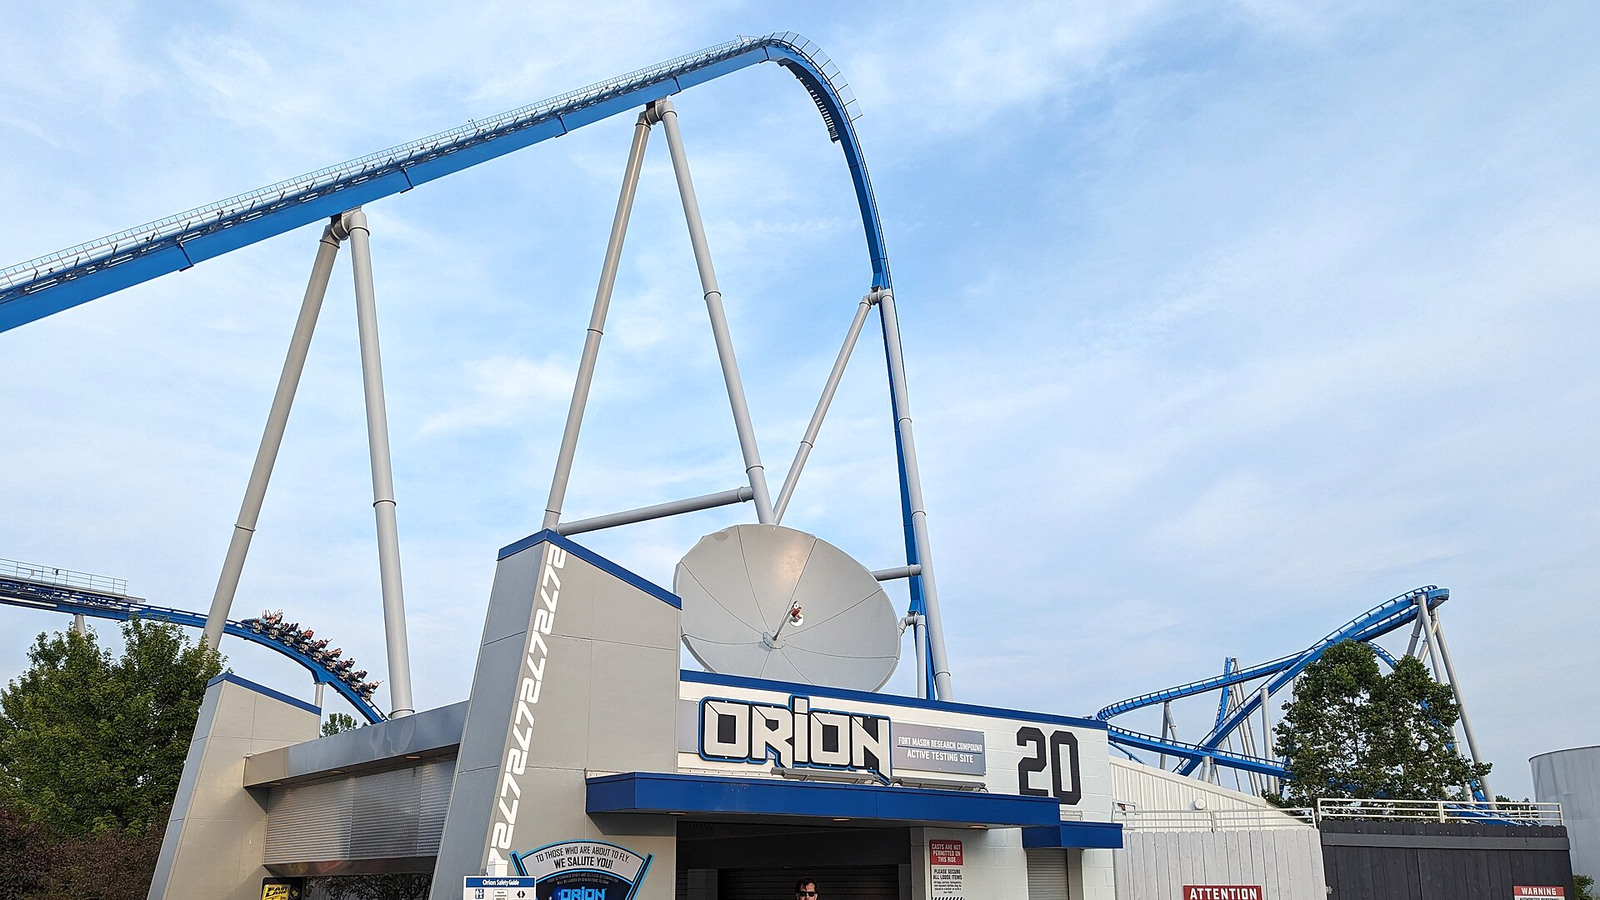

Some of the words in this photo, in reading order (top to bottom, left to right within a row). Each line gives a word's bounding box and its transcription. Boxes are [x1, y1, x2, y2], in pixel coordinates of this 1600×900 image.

[898, 736, 911, 746] FORT
[912, 737, 930, 748] MASON
[931, 739, 956, 750] RESEARCH
[957, 741, 983, 753] COMPOUND
[907, 749, 930, 760] ACTIVE
[931, 751, 958, 762] TESTING
[959, 753, 974, 764] SITE
[1016, 726, 1083, 806] 20
[535, 854, 544, 864] TO
[545, 848, 564, 861] THOSE
[565, 846, 579, 855] WHO
[580, 845, 590, 854] ARE
[592, 846, 610, 857] ABOUT
[611, 849, 619, 860] TO
[553, 858, 566, 870] WE
[567, 856, 595, 868] SALUTE
[596, 856, 614, 870] YOU!
[496, 879, 508, 887] Safety
[1189, 887, 1257, 900] ATTENTION
[1520, 887, 1557, 896] WARNING
